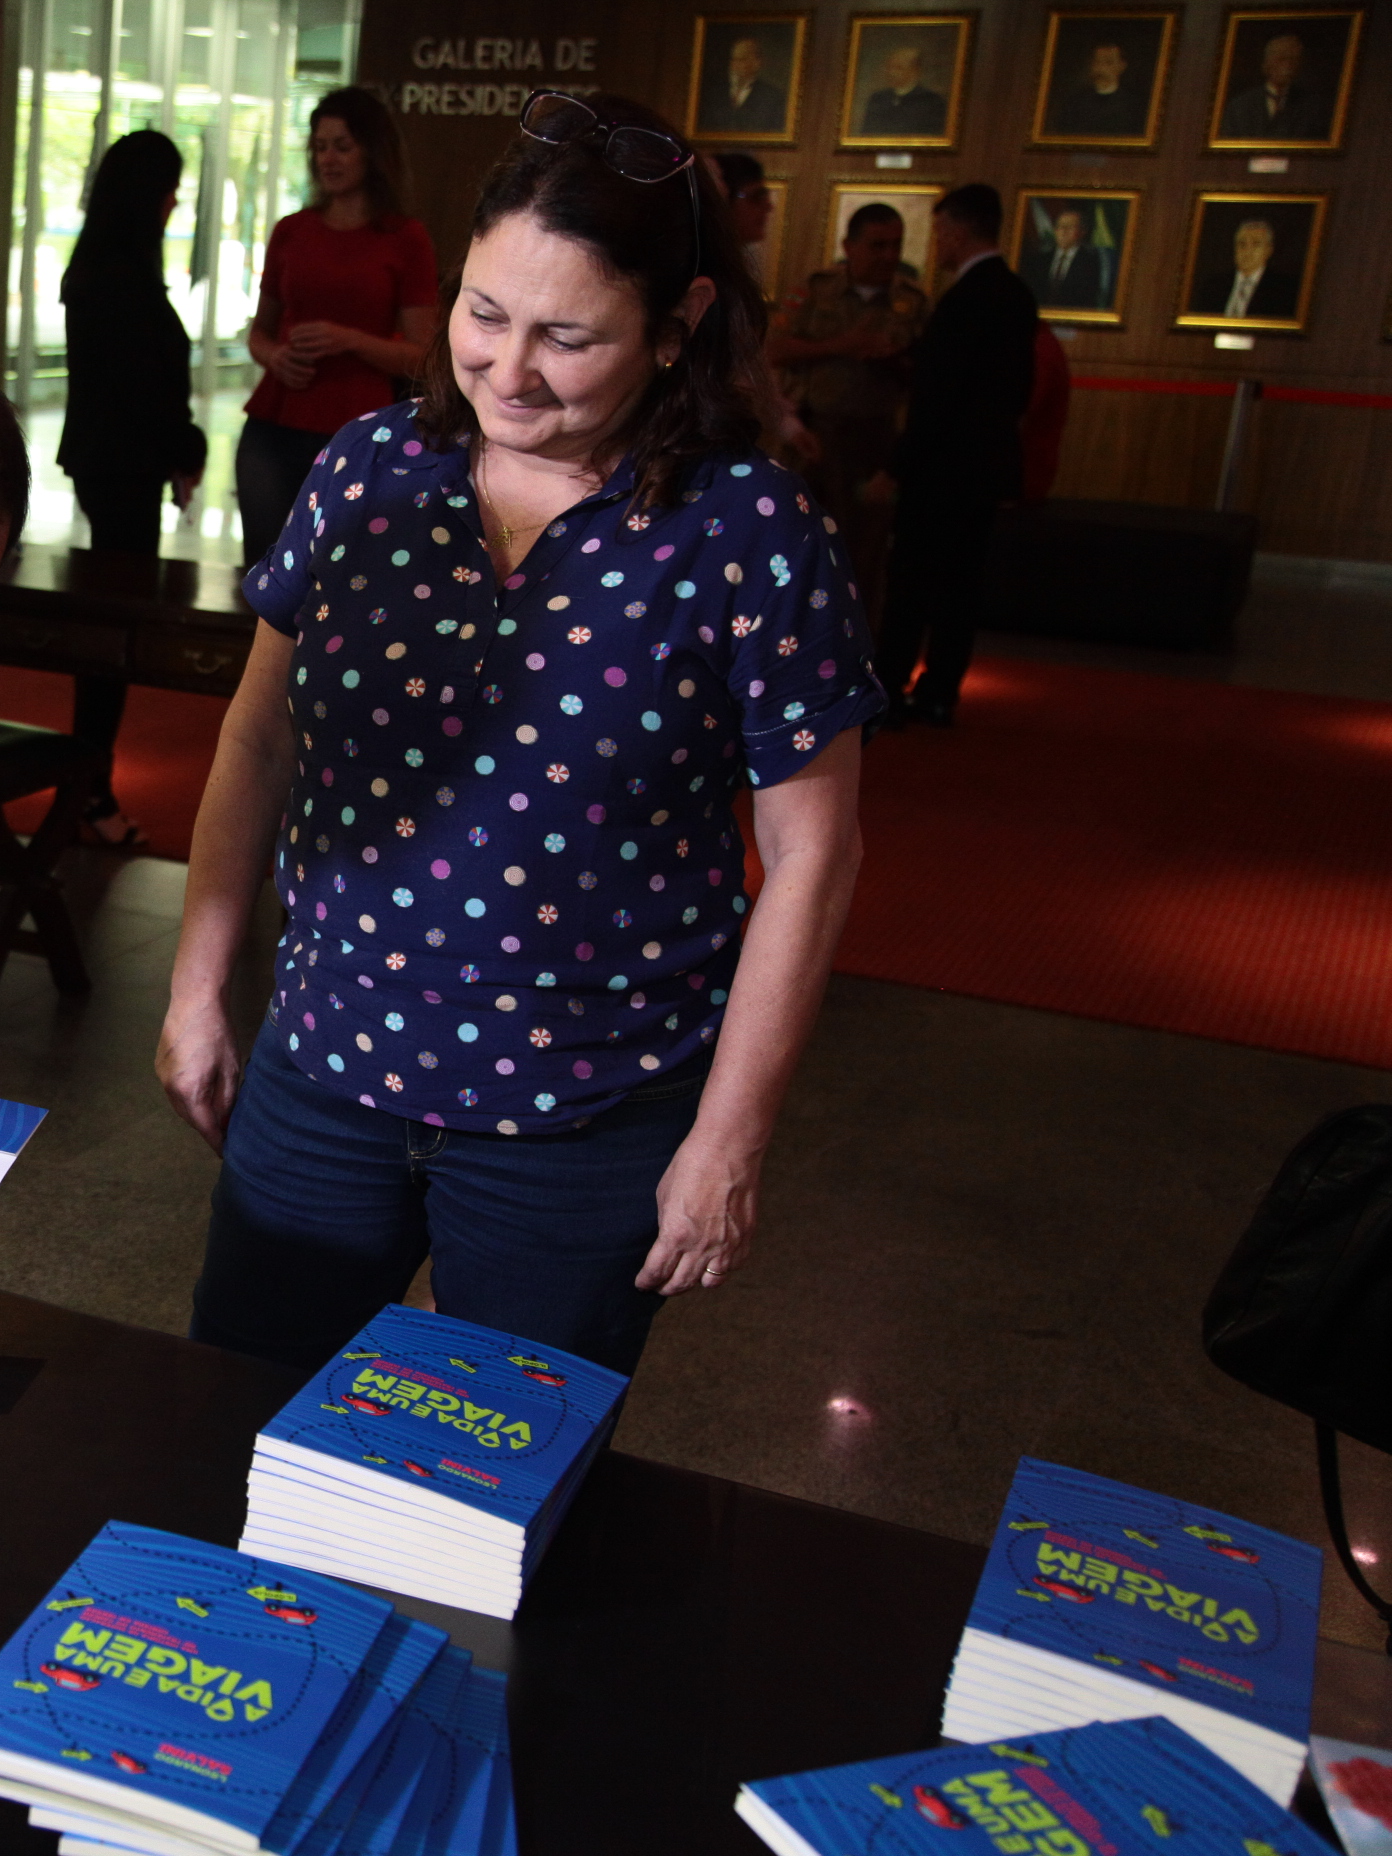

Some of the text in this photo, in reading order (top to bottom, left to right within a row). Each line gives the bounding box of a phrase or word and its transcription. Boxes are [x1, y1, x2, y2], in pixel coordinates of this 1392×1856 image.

[412, 37, 599, 71] GALERIA DE
[352, 1382, 411, 1410] UMA
[354, 1368, 532, 1443] VIAGEM
[1036, 1560, 1111, 1595] UMA
[1036, 1541, 1260, 1636] VIAGEM
[54, 1643, 126, 1678] UMA
[59, 1621, 274, 1710] VIAGEM
